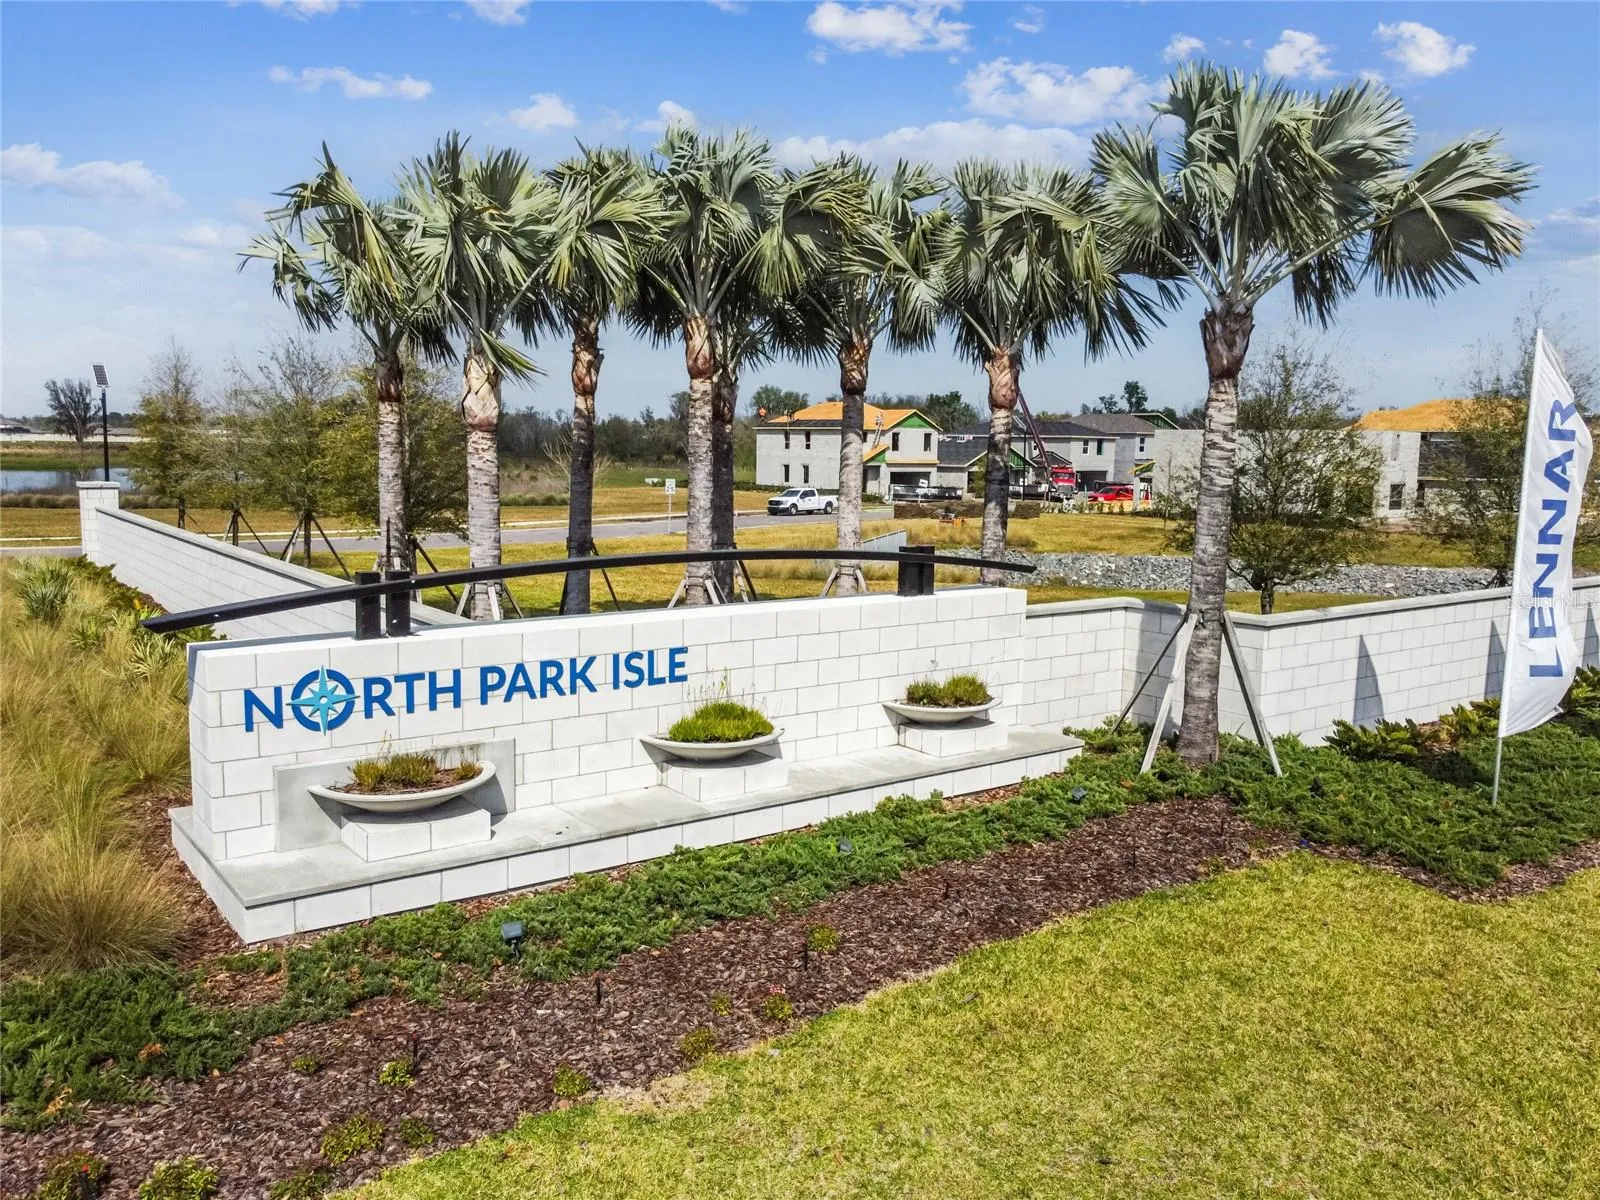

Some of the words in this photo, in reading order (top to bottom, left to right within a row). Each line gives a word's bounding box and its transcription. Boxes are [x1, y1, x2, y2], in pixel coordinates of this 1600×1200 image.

[1528, 400, 1577, 678] LENNAR
[243, 666, 462, 733] NORTH
[480, 656, 597, 705] PARK
[612, 647, 688, 690] ISLE
